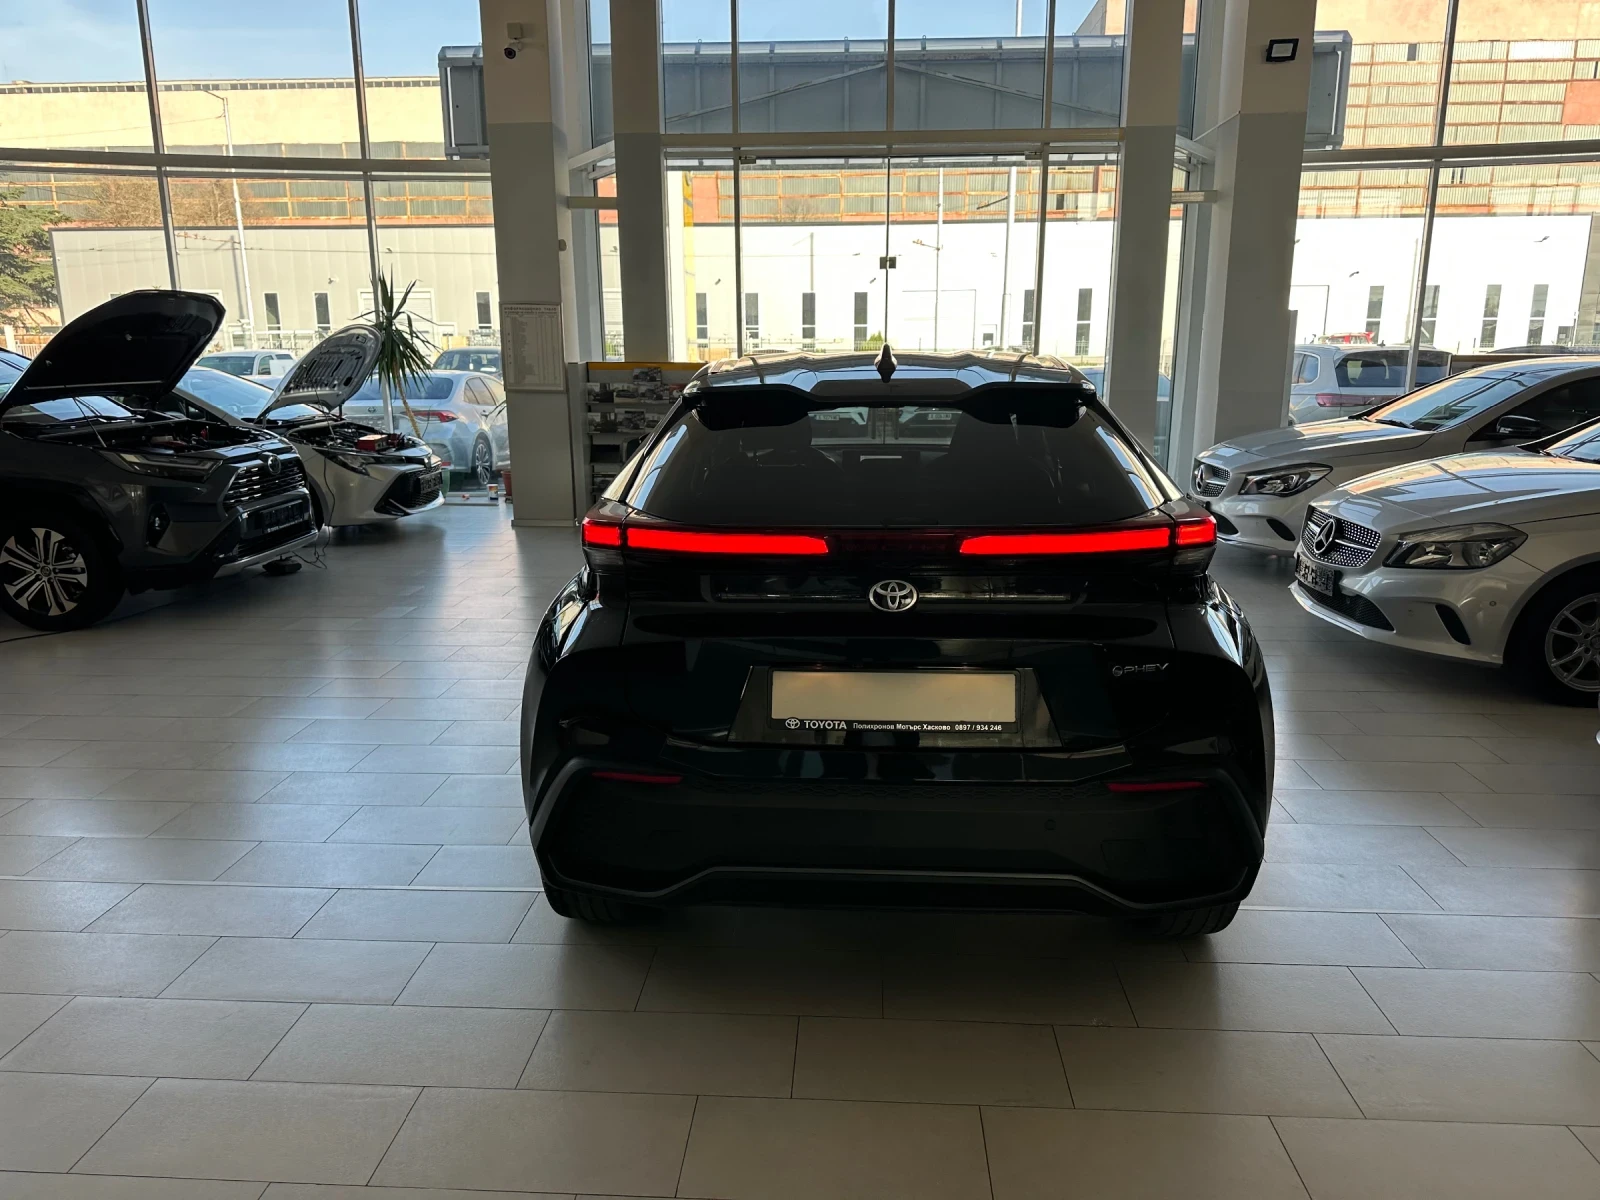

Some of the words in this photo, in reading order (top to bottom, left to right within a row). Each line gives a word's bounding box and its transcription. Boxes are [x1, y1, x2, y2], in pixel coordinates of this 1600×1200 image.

[1123, 662, 1169, 673] PHEV
[803, 720, 847, 729] TOYOTA
[853, 722, 895, 730] Полихронов
[896, 723, 921, 731] Мотърс
[922, 723, 951, 731] Хасково
